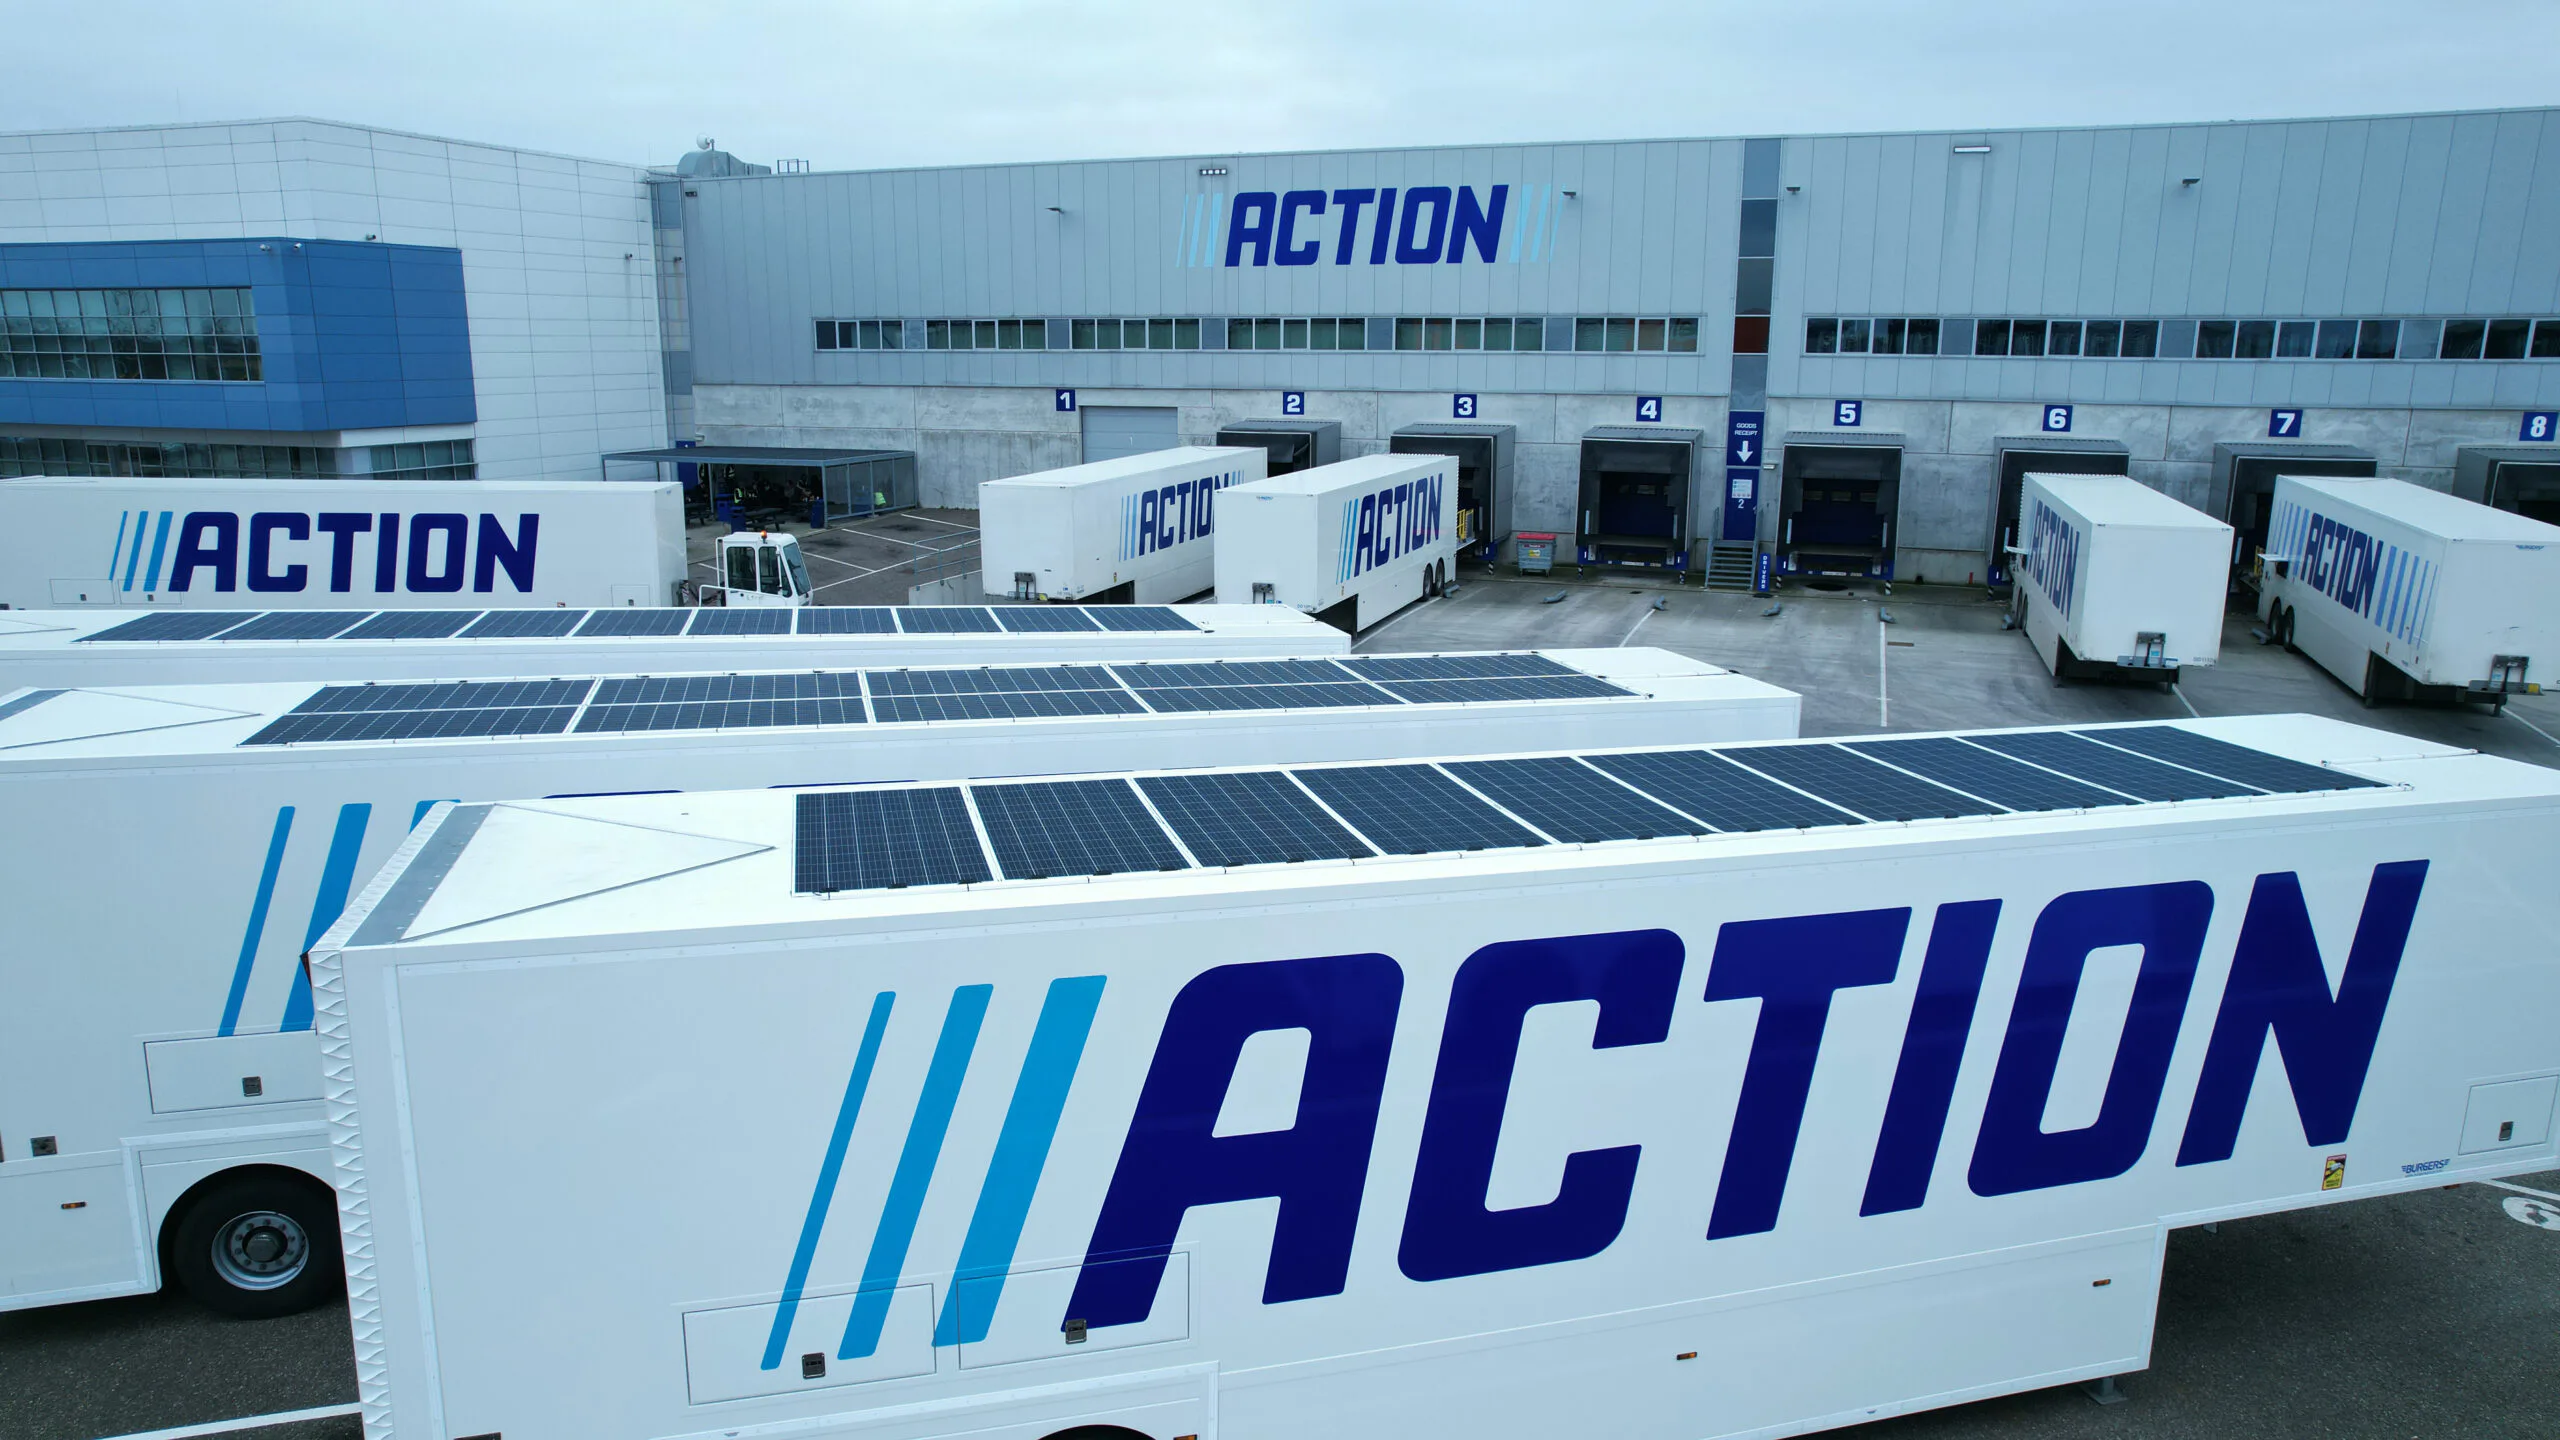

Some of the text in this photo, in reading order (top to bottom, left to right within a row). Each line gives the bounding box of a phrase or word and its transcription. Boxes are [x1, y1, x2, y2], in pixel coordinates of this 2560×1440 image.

[1225, 185, 1508, 267] ACTION
[1060, 392, 1070, 409] 1
[1287, 395, 1300, 413] 2
[1459, 397, 1472, 416] 3
[1641, 400, 1657, 419] 4
[1840, 404, 1855, 422] 5
[2049, 409, 2066, 428] 6
[2278, 413, 2296, 434] 7
[2530, 415, 2547, 438] 8
[1738, 499, 1744, 508] 2
[1139, 473, 1229, 556] ACTIO
[1354, 473, 1443, 577] ACTION
[169, 511, 540, 593] ACTION
[2028, 499, 2080, 622] ACTION
[2300, 512, 2384, 619] ACTION
[1061, 859, 2430, 1333] ACTION
[2405, 1159, 2444, 1174] BURGERS
